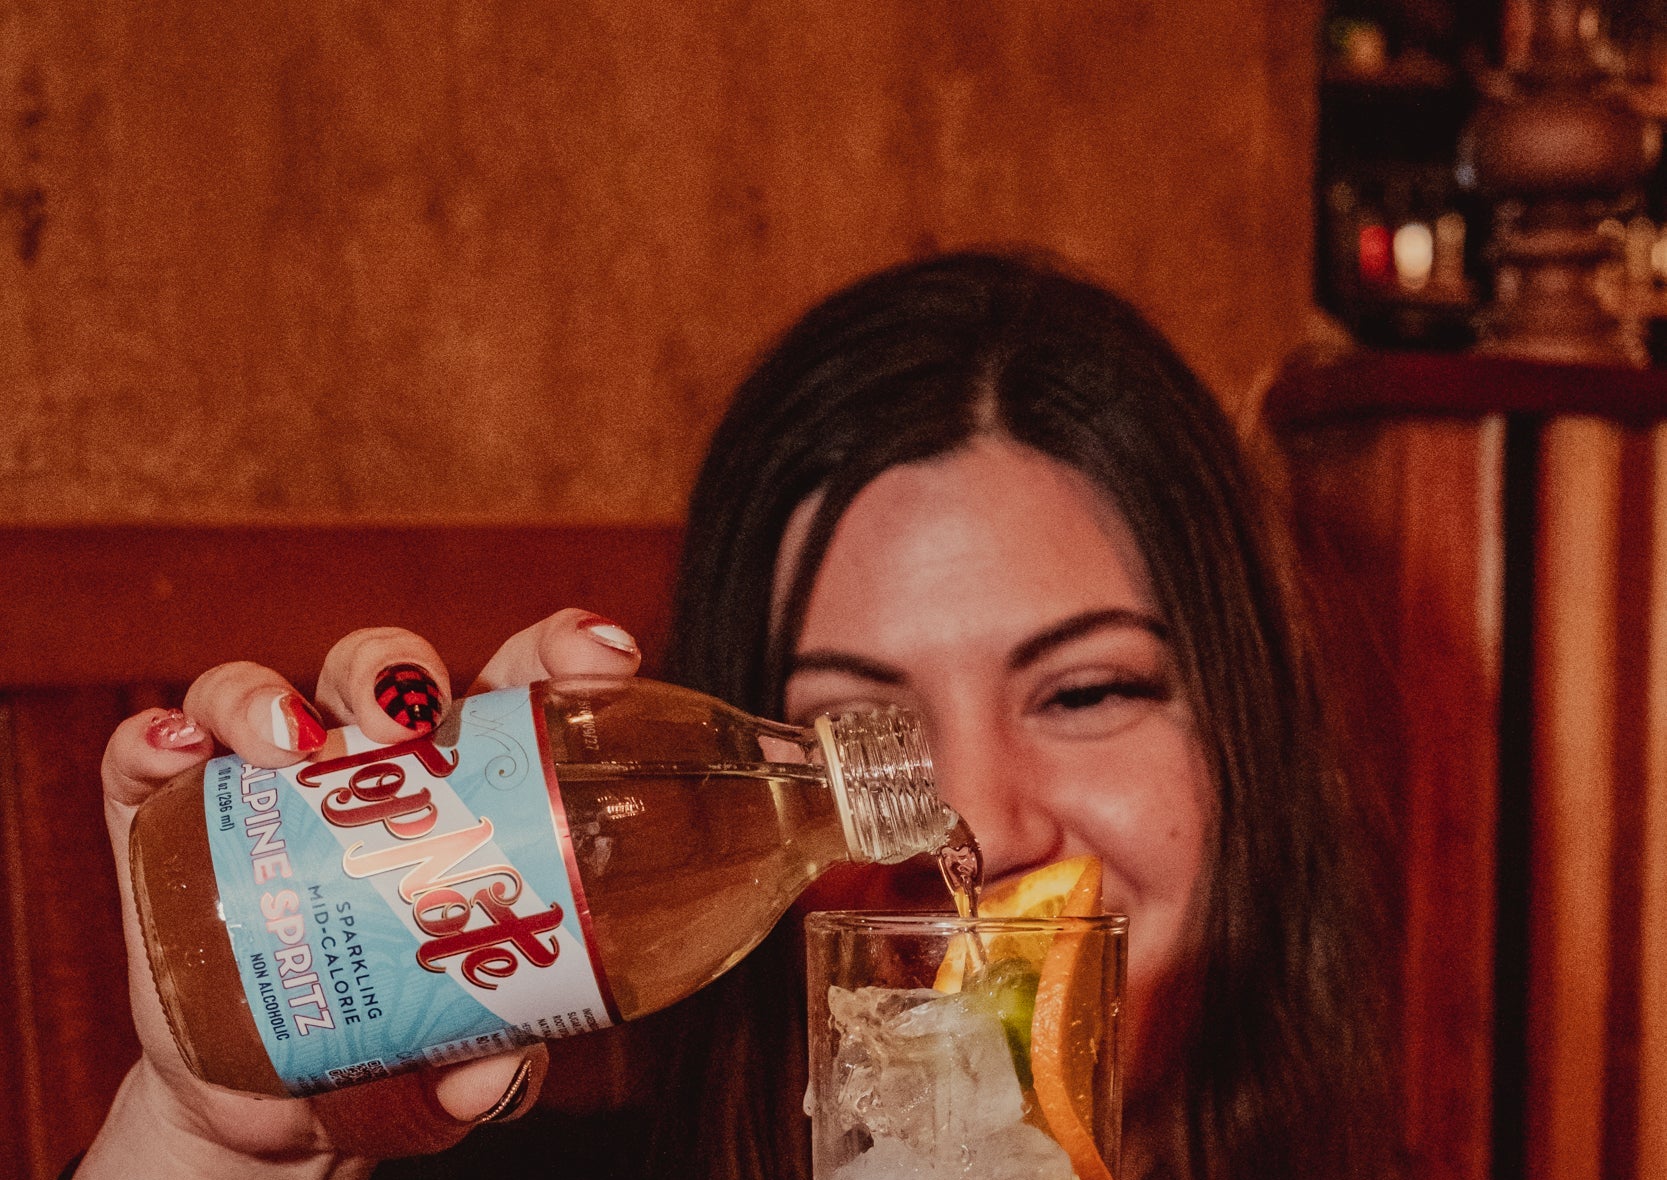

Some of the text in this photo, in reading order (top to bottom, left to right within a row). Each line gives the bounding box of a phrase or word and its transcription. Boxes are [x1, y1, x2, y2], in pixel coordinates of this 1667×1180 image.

[216, 791, 233, 813] (296
[218, 782, 228, 791] oz
[219, 814, 235, 832] ml)
[250, 953, 290, 1041] NON ALCOHOLIC
[260, 888, 335, 1037] SPRITZ
[308, 885, 361, 1026] MID-CALORIE
[335, 901, 383, 1020] SPARKLING
